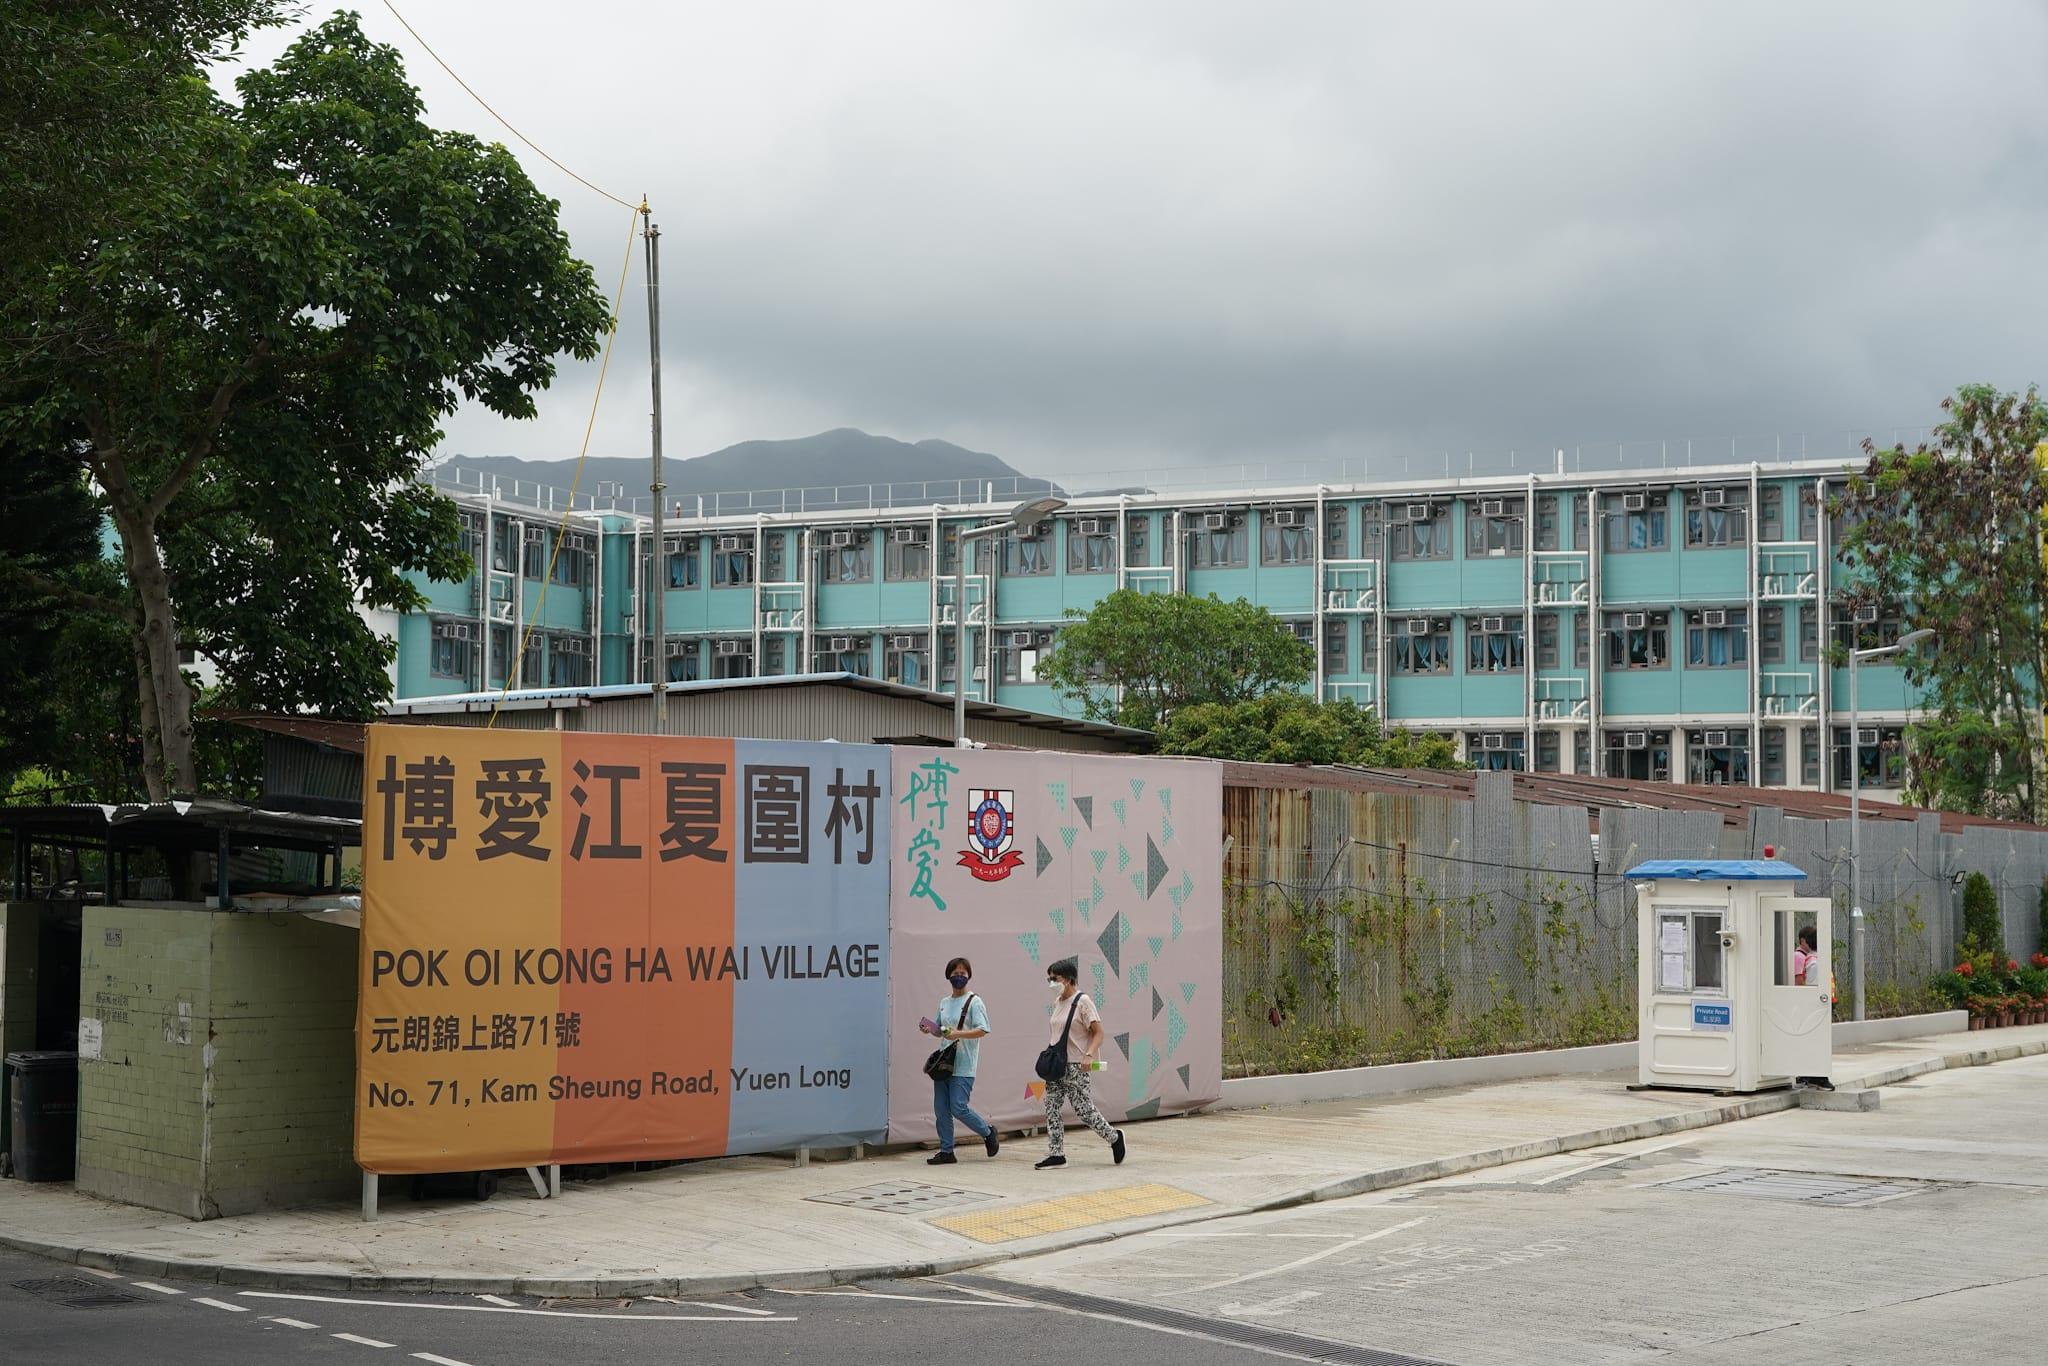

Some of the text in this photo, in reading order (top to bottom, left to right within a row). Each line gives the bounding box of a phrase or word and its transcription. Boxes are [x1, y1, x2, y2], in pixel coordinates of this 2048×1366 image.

[376, 755, 881, 864] 博愛江夏圍村
[372, 944, 880, 987] POK OI KONG HA WAI VILLAGE
[371, 1012, 581, 1054] 元朗錦上路71號
[369, 1066, 851, 1108] No. 71, Kam Sheung Road, Yuen Long
